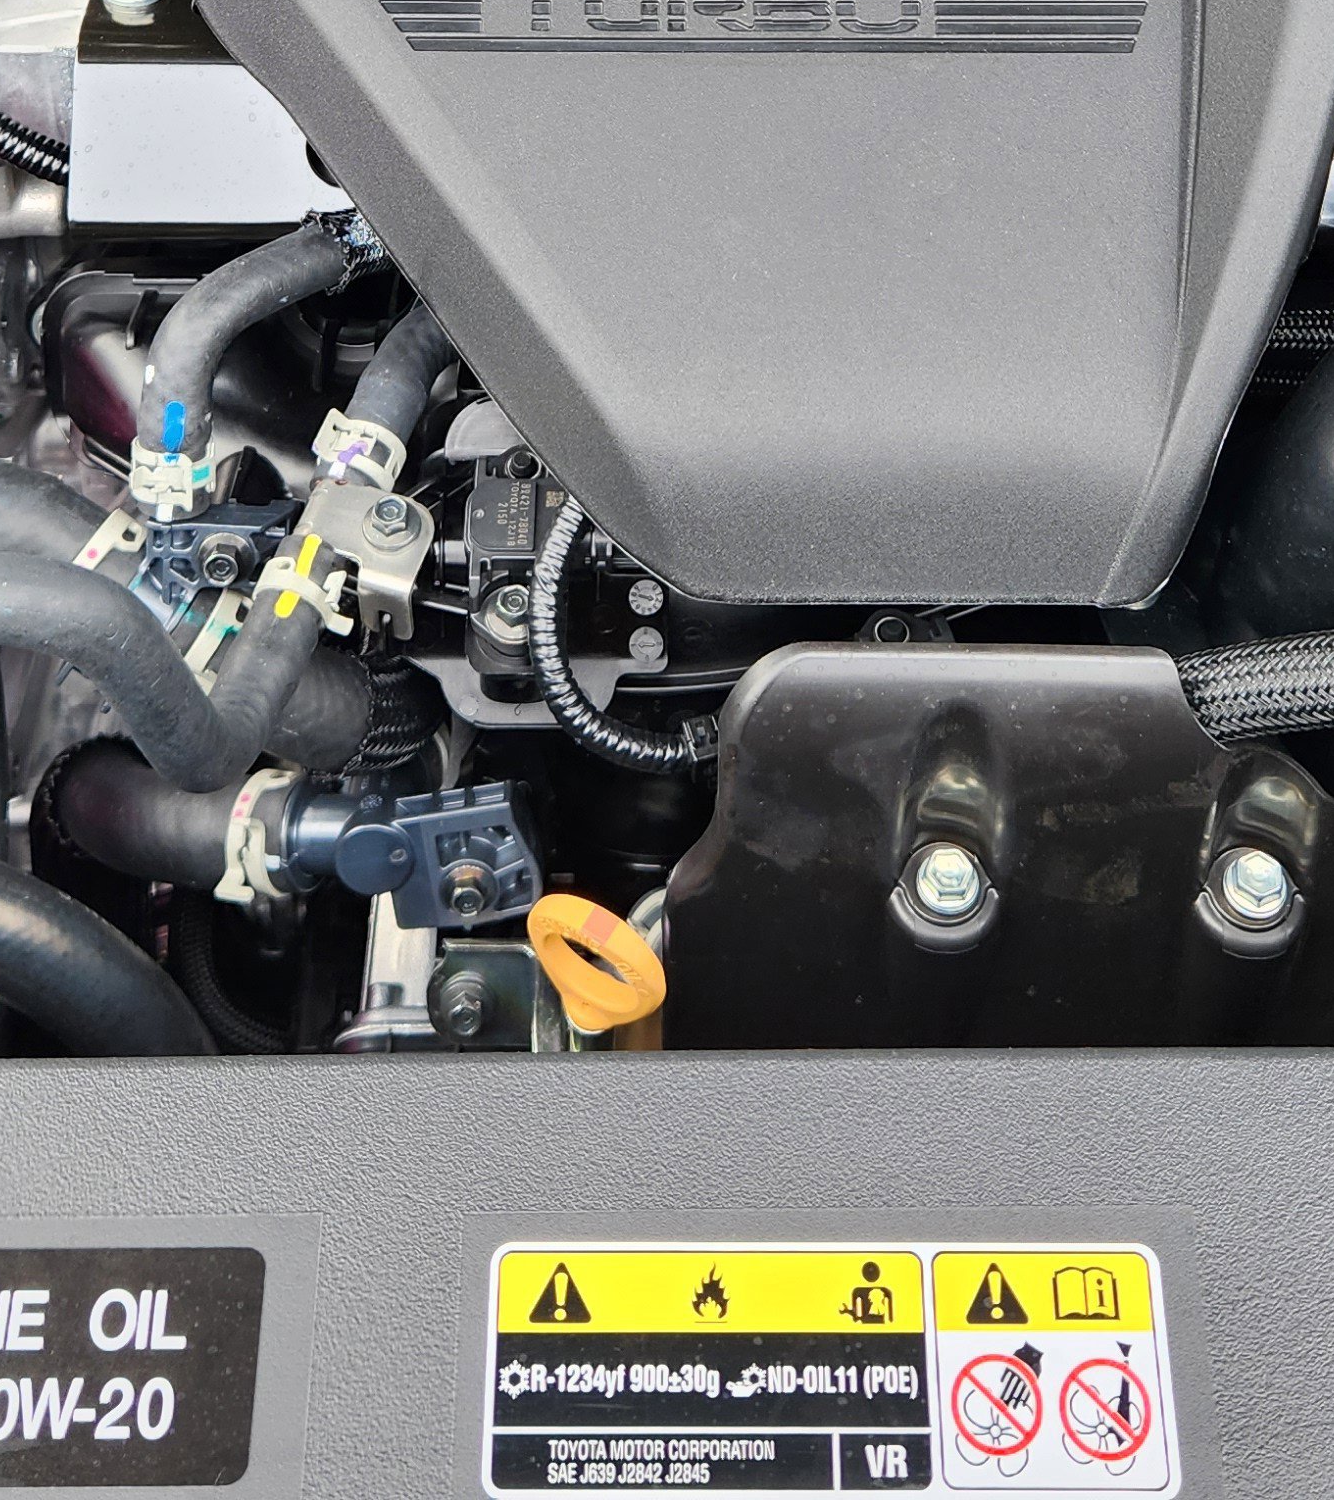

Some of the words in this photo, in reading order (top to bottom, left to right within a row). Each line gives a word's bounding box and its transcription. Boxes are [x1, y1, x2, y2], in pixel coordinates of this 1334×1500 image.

[496, 501, 509, 526] 2150
[508, 481, 521, 515] TOYOTA
[88, 1288, 187, 1351] OIL
[530, 1362, 626, 1397] R-1234yf
[628, 1362, 720, 1398] 900±30g
[766, 1364, 859, 1395] ND-OIL11
[863, 1364, 919, 1399] (POE)
[549, 1439, 608, 1462] TOYOTA
[609, 1439, 665, 1462] MOTOR
[666, 1439, 776, 1462] CORPORATION
[865, 1445, 909, 1480] VR
[546, 1463, 578, 1485] SAE
[579, 1463, 616, 1485] J639
[617, 1463, 664, 1485] J2842
[665, 1463, 711, 1485] J2845
